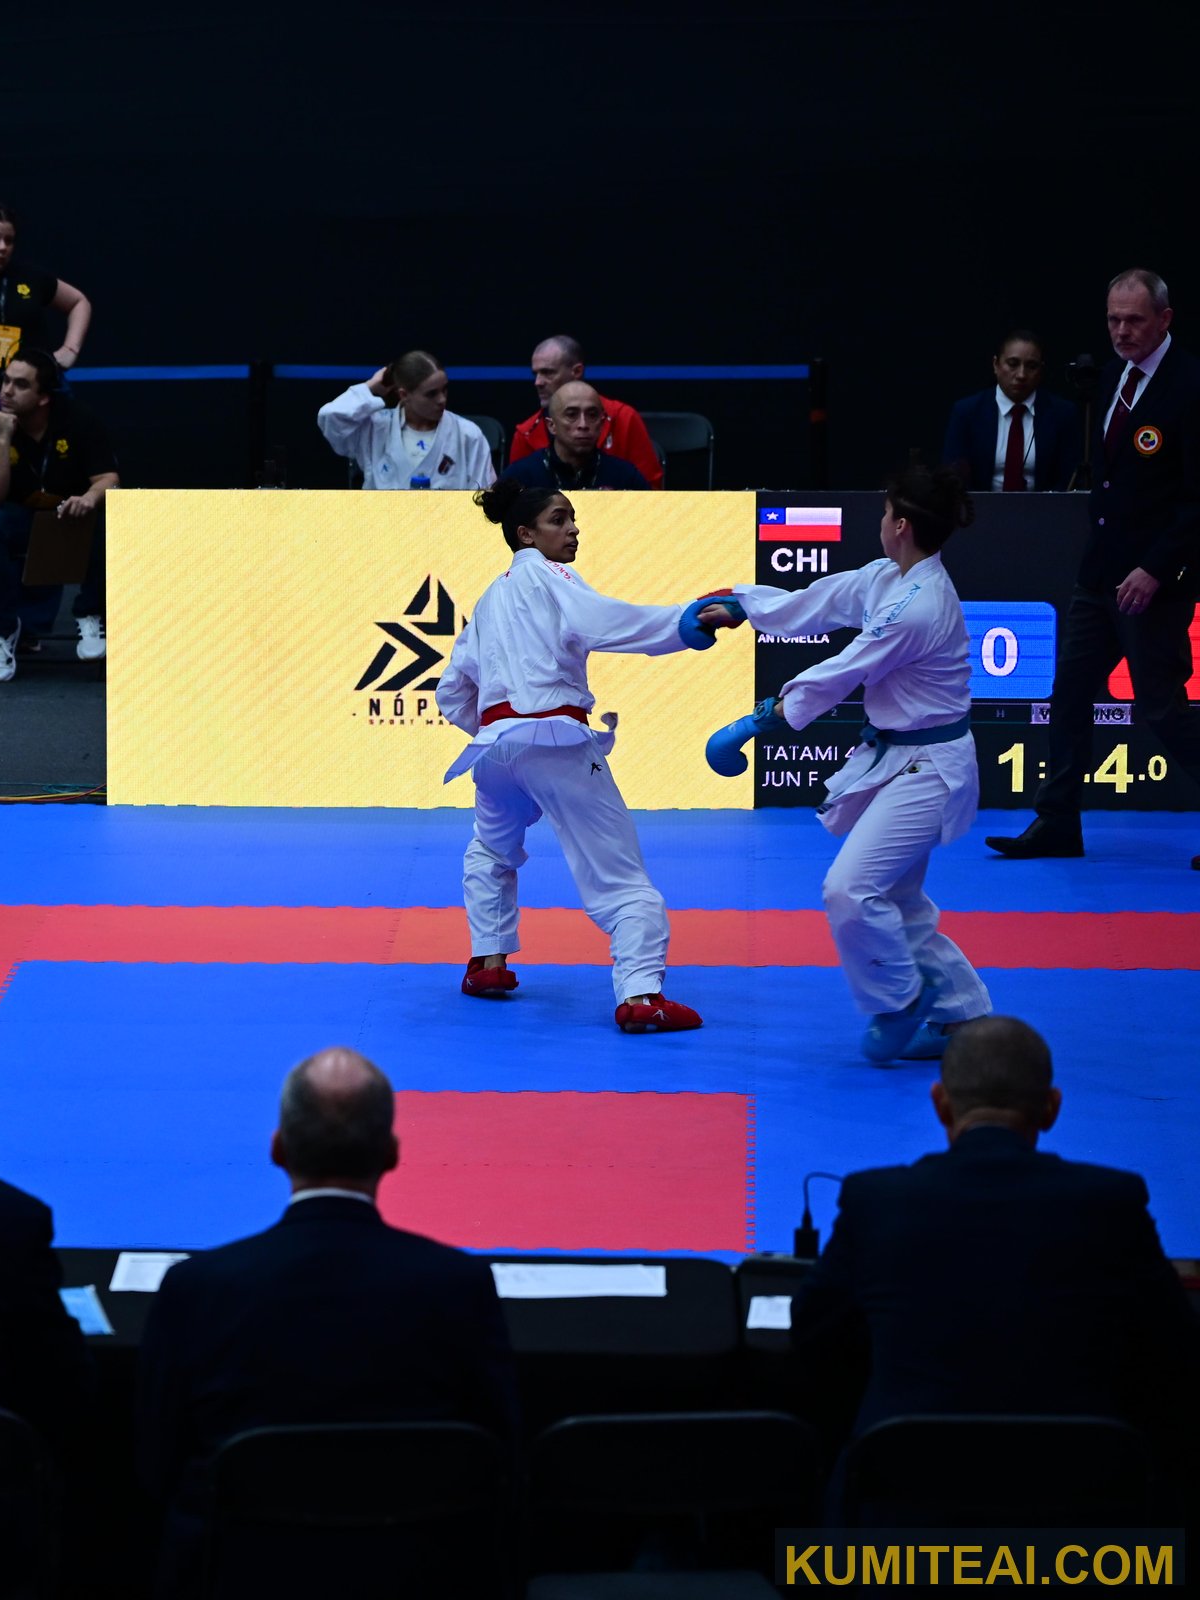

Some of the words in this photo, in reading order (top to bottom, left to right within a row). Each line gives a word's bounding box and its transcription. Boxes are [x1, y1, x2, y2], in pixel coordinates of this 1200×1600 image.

[770, 547, 829, 573] CHI
[981, 626, 1019, 677] 0
[369, 692, 443, 716] NÓP
[763, 745, 838, 761] TATAMI
[761, 770, 801, 787] JUN
[808, 770, 819, 787] F
